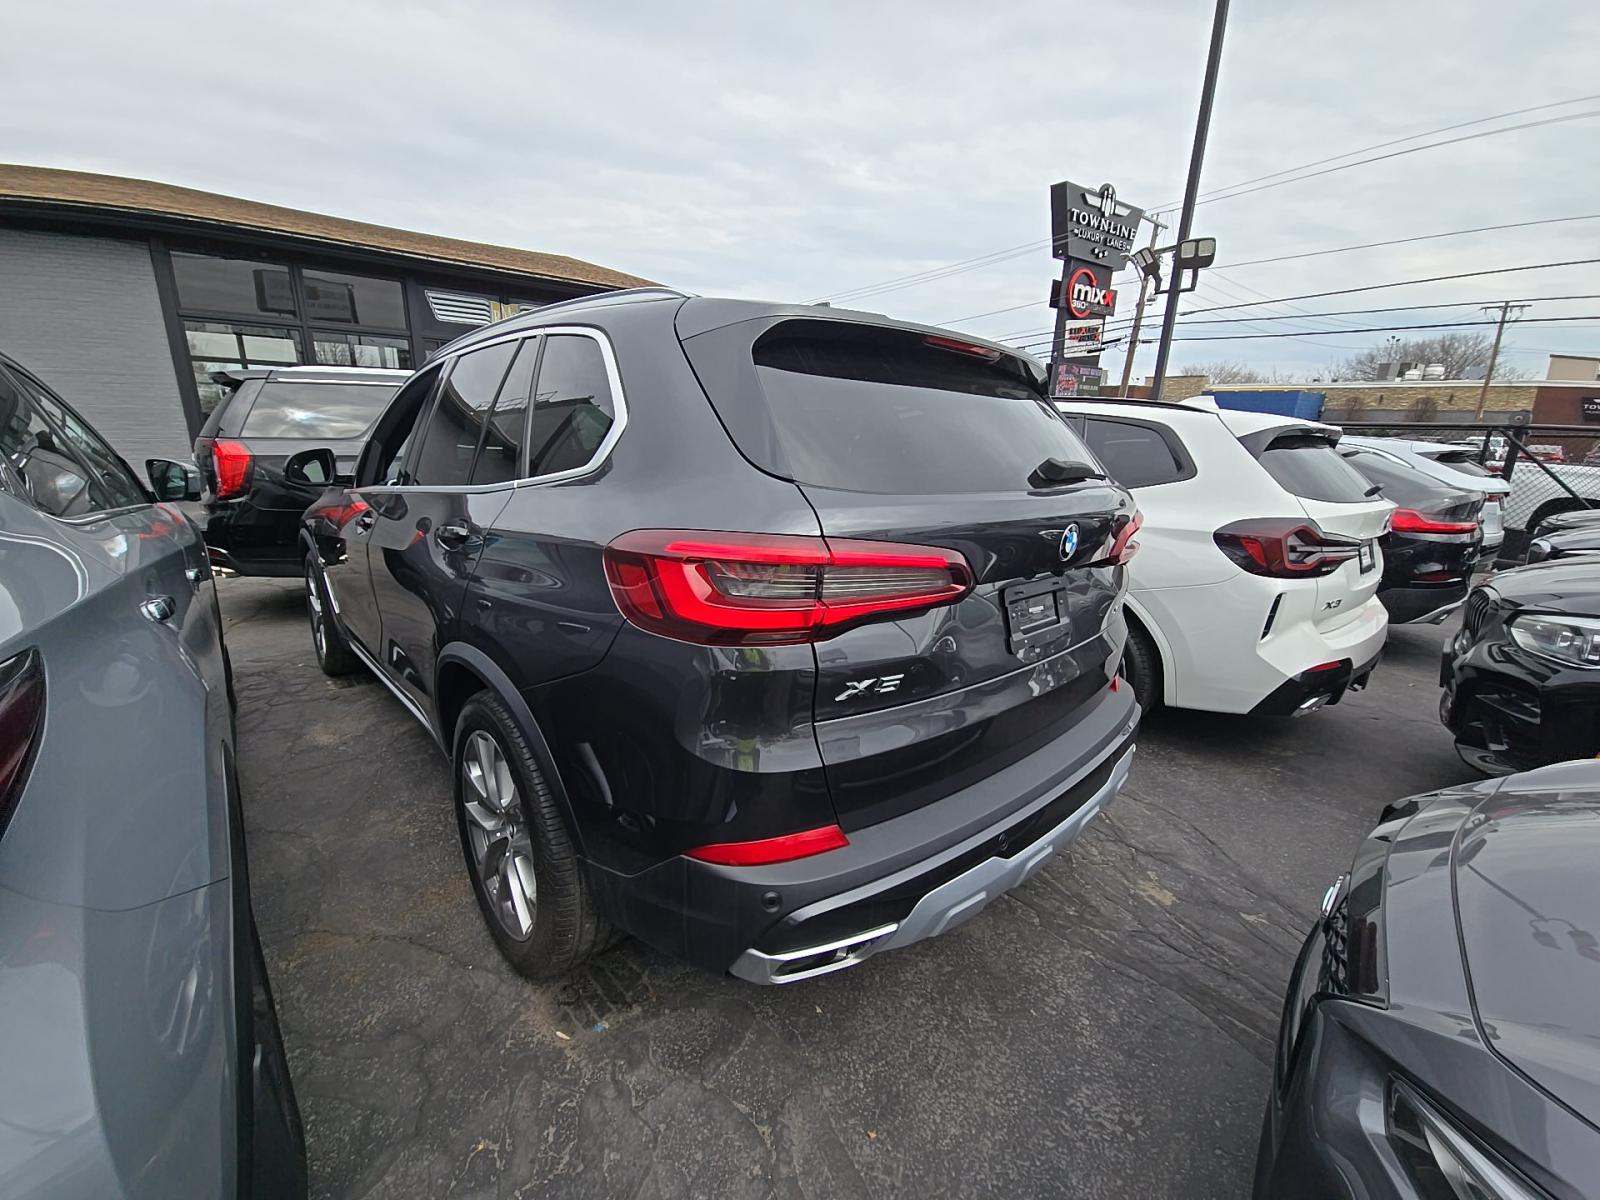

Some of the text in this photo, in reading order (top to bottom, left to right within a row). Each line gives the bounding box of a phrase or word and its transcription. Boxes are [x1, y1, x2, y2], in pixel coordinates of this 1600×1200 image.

[1071, 208, 1137, 240] TOWNLINE
[1078, 228, 1127, 251] LUXURY LANES
[1321, 599, 1342, 612] X3
[834, 674, 905, 701] X5
